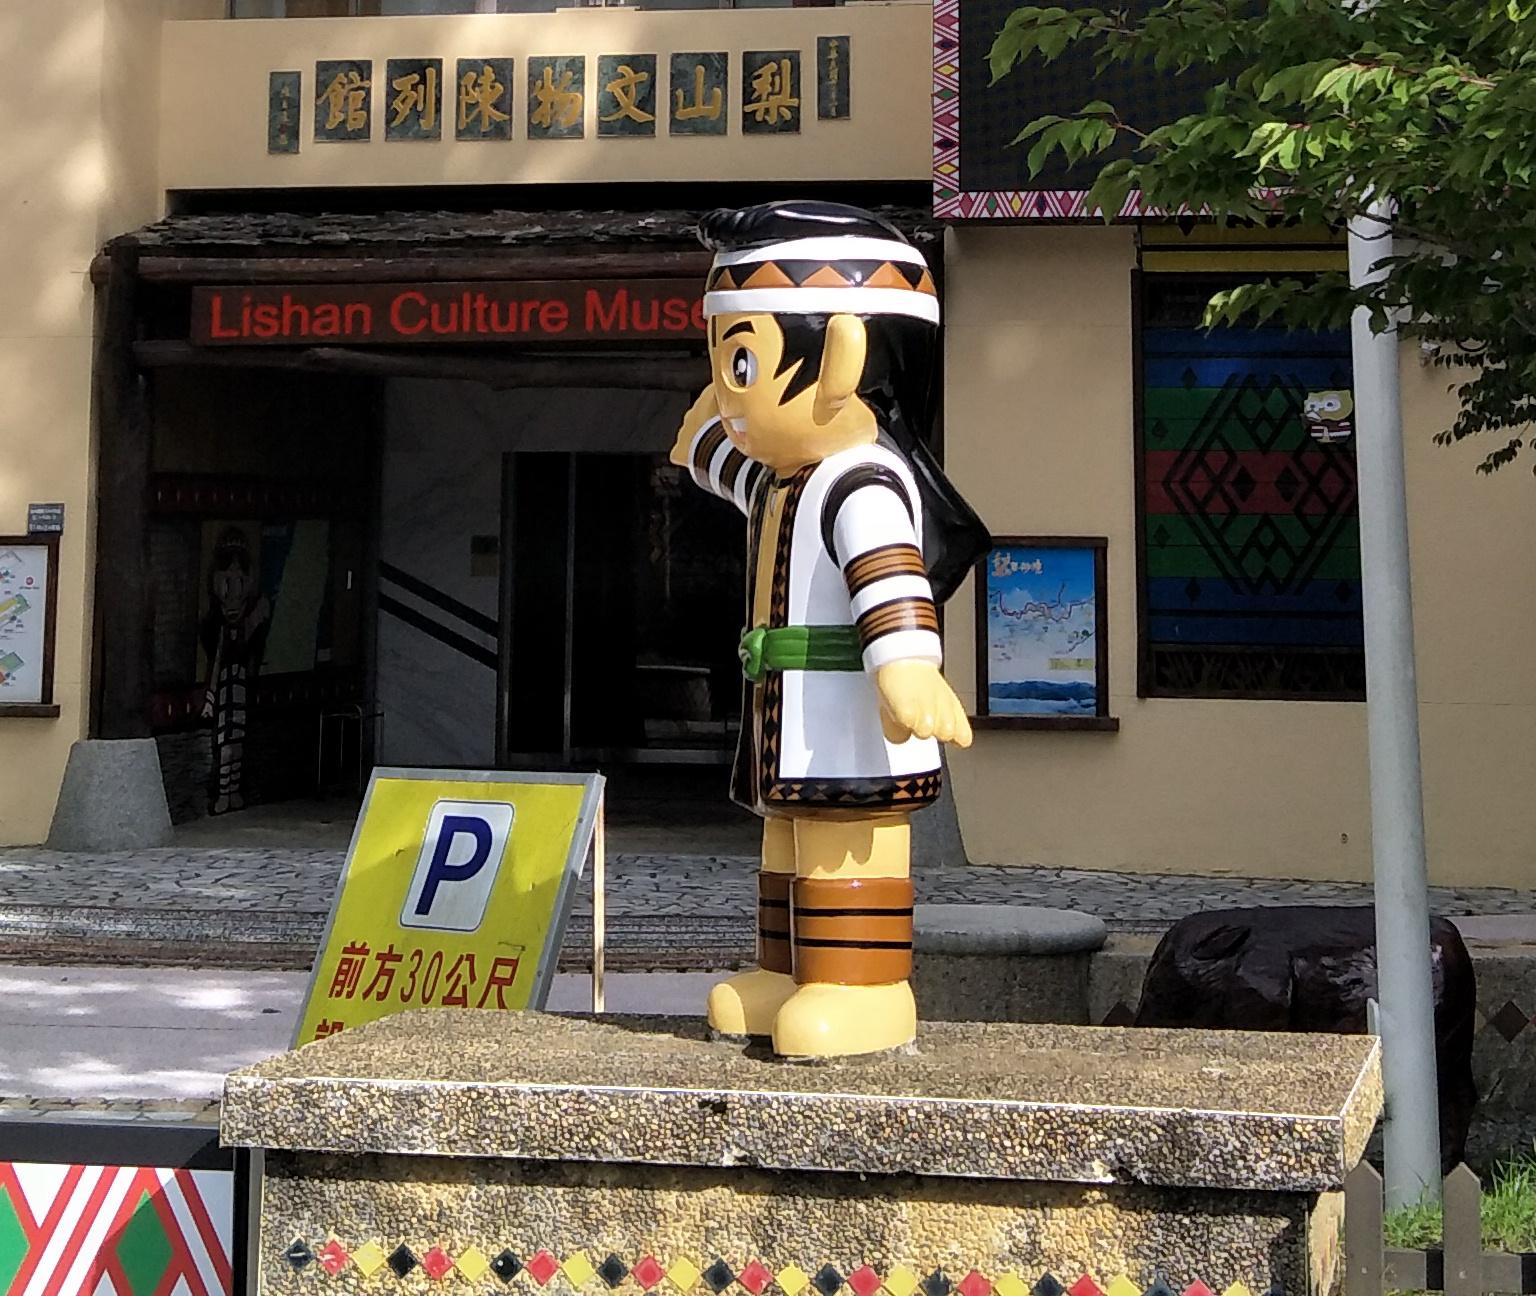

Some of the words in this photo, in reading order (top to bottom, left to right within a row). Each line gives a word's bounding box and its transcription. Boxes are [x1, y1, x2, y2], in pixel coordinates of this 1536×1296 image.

[210, 293, 371, 339] Lishan
[390, 290, 569, 335] Culture
[415, 815, 493, 916] P
[328, 940, 520, 1009] 前方30公尺
